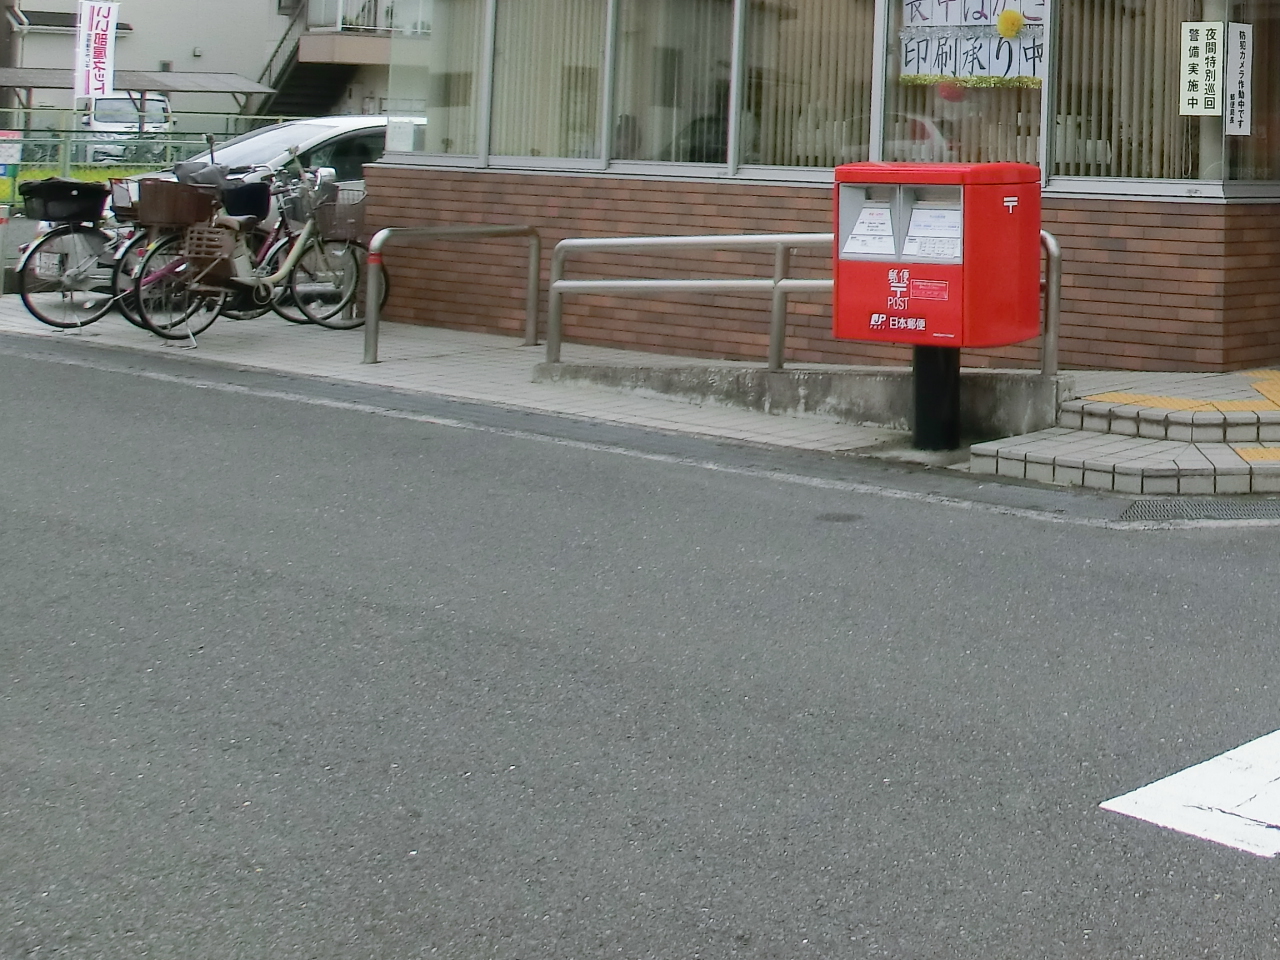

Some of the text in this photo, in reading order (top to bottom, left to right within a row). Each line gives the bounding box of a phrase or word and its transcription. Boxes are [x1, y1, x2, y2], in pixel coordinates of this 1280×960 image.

[904, 37, 1044, 77] 印刷承り中
[1187, 28, 1200, 109] 警備実施中
[1204, 28, 1217, 109] 夜間特別巡回
[1238, 30, 1246, 129] 防犯カメラ作動中です
[888, 268, 910, 284] 郵便
[887, 296, 909, 310] POST
[889, 316, 927, 331] 日本郵便
